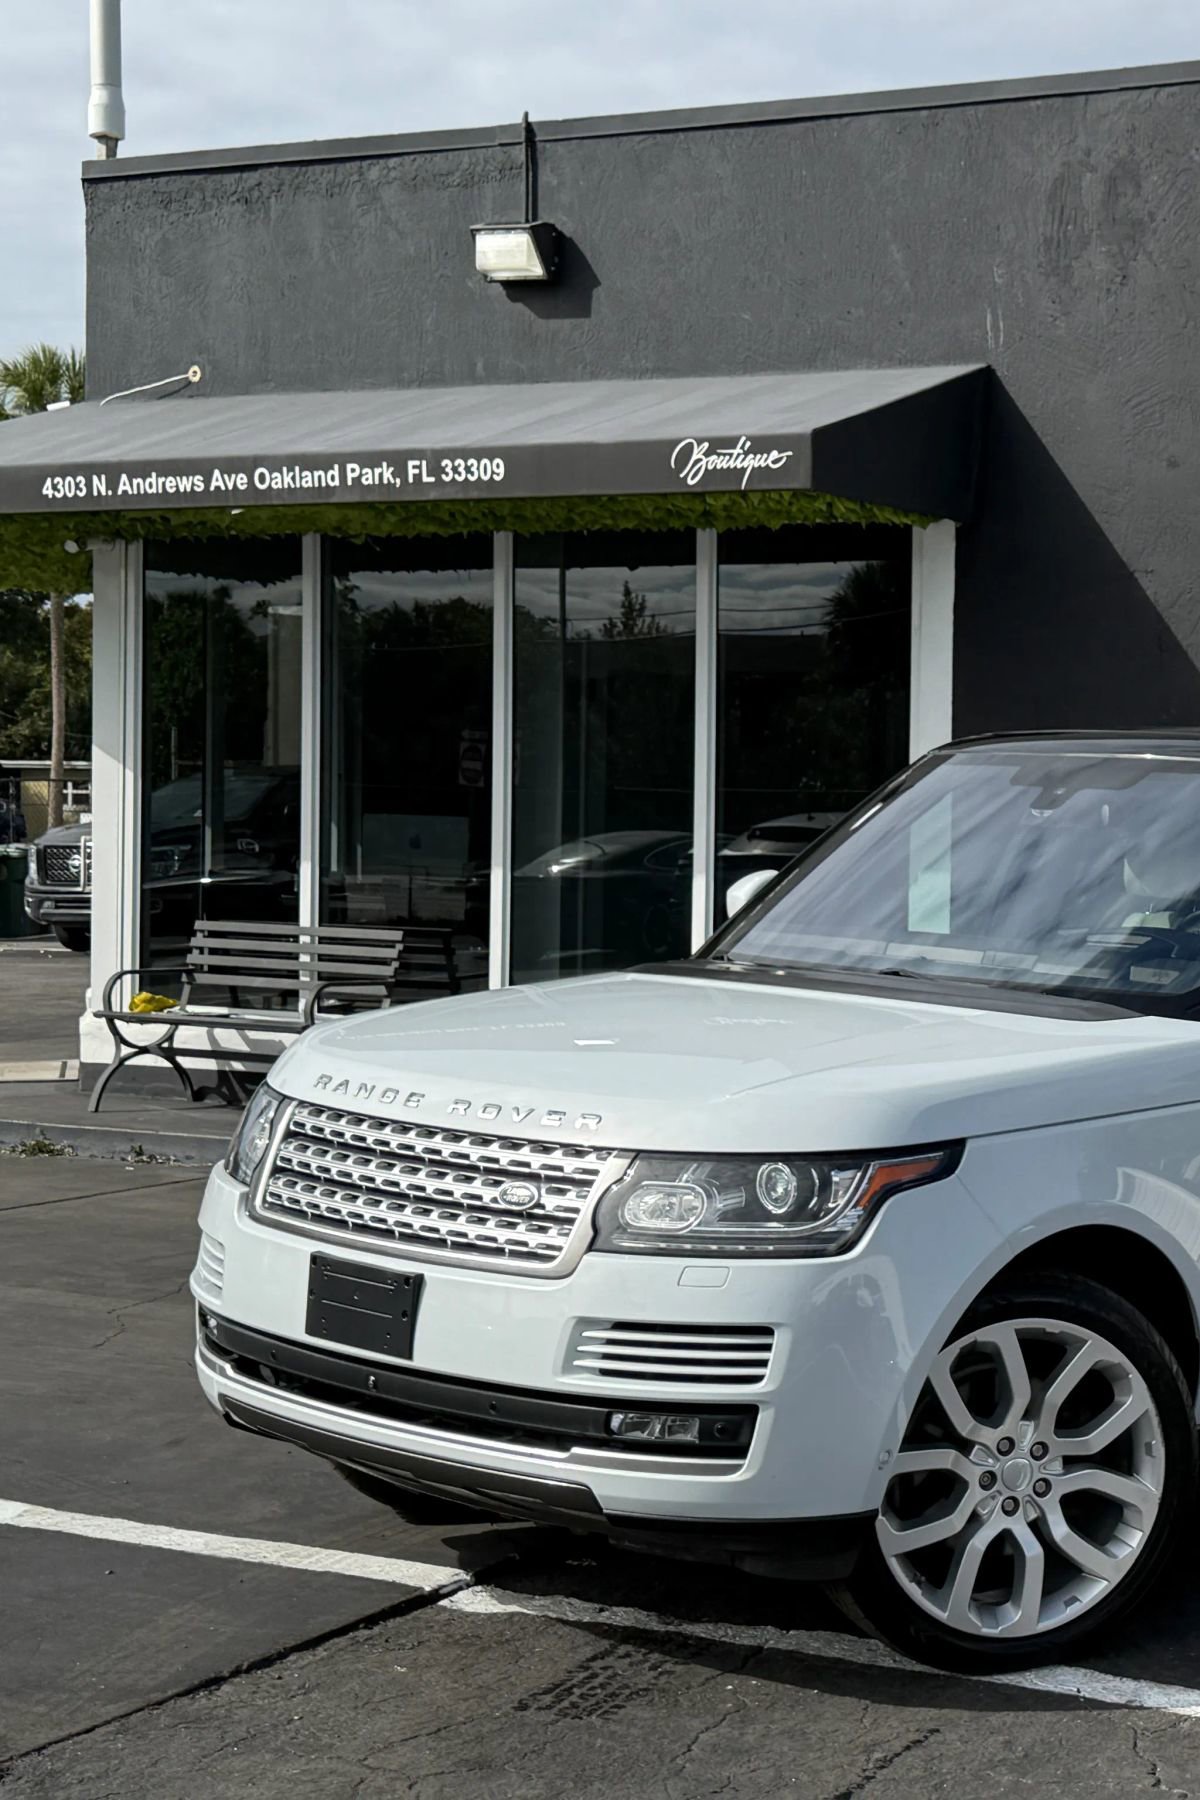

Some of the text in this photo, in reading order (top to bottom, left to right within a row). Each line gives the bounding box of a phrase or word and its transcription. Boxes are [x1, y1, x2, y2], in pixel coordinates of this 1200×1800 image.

[42, 458, 505, 499] 4303 N. Andrews Ave Oakland Park, FL 33309
[670, 435, 793, 490] Boutique
[312, 1074, 603, 1131] RANGE ROVER
